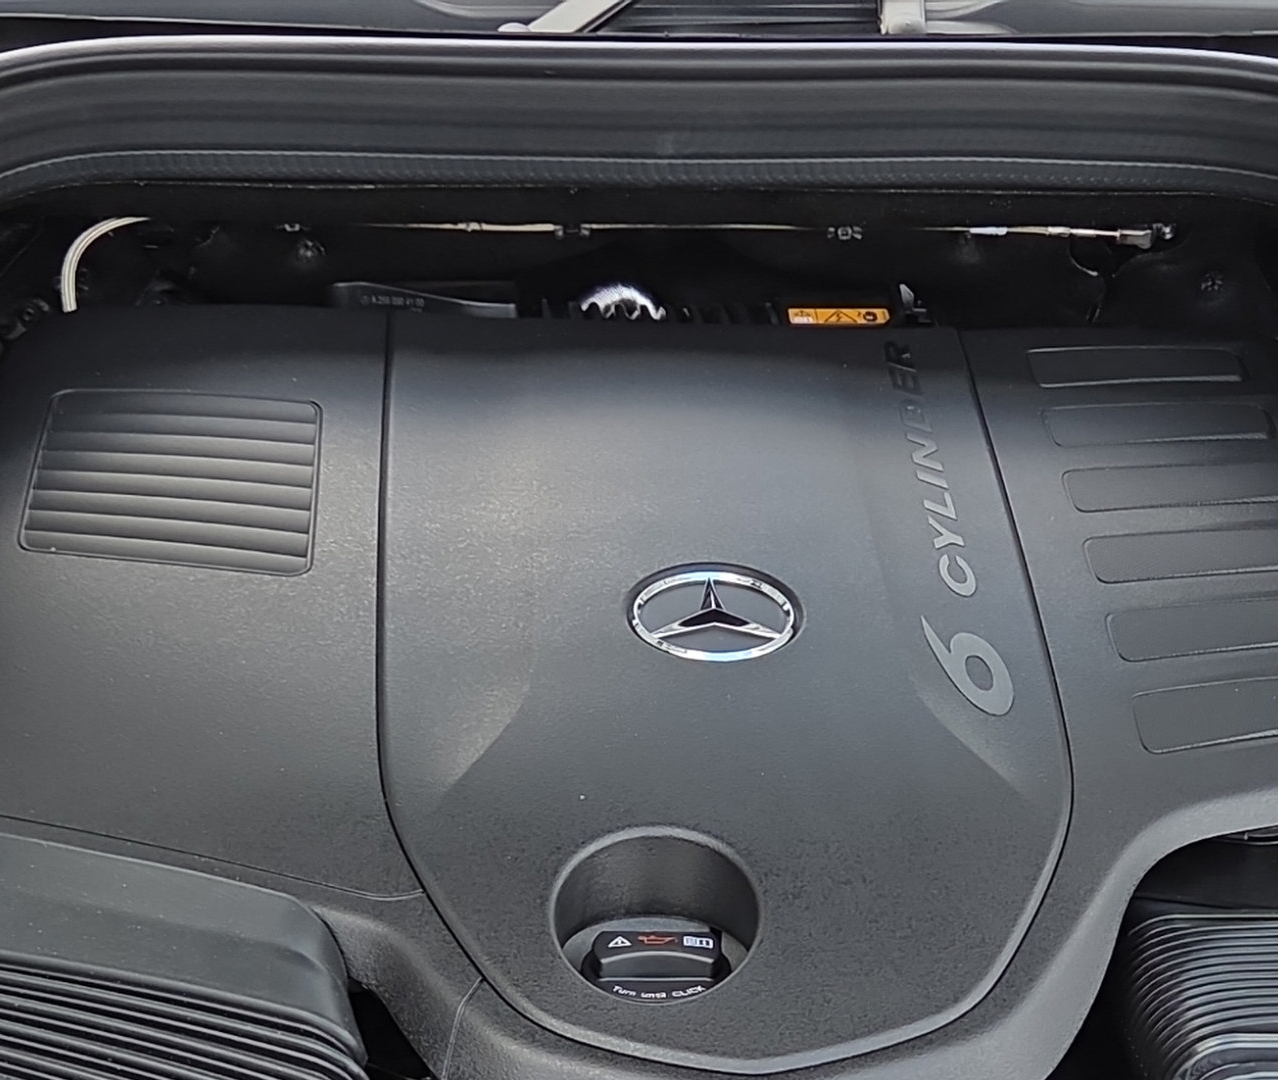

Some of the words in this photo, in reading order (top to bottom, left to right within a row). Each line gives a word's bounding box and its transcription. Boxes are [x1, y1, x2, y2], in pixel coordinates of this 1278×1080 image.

[882, 339, 976, 597] CYLINDER
[920, 614, 1014, 716] 6
[612, 985, 637, 997] Turn
[672, 985, 706, 997] CLICK
